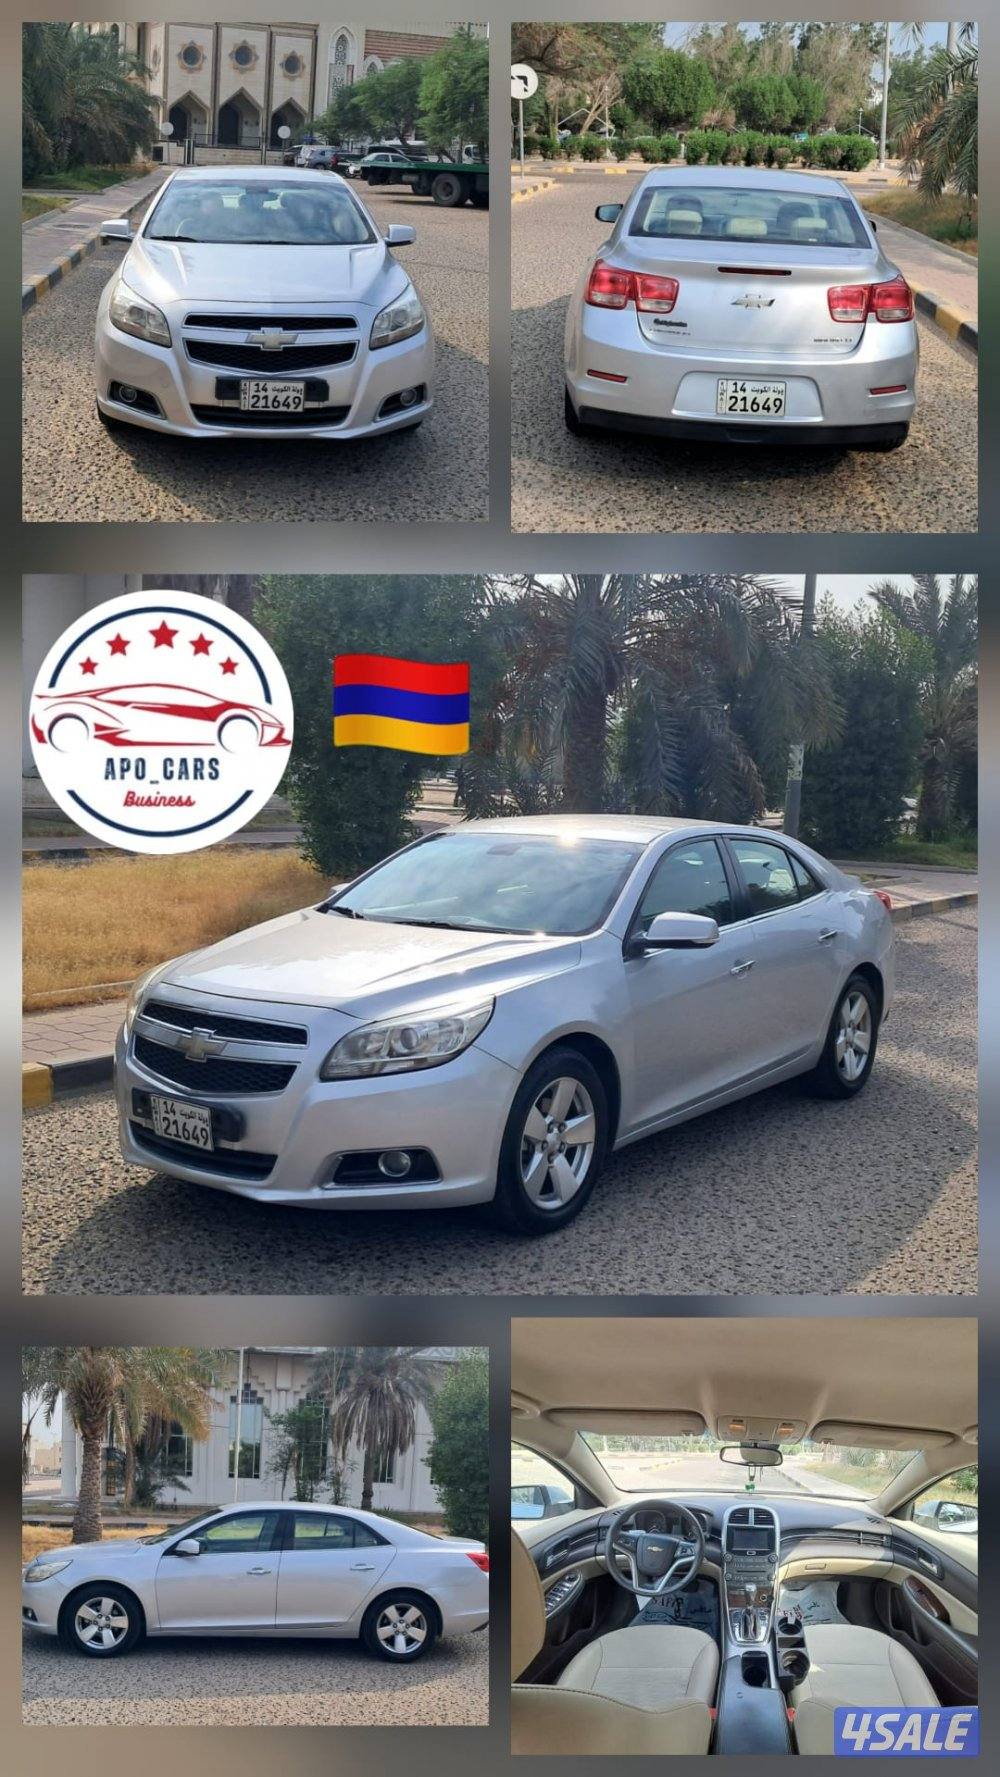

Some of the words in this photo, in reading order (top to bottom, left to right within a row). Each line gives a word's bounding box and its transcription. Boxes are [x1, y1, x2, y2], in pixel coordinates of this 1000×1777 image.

[254, 382, 268, 393] 14
[732, 381, 746, 393] 14
[250, 394, 302, 410] 21649
[728, 395, 783, 414] 21649
[163, 1100, 176, 1116] 14
[162, 1116, 209, 1146] 21649
